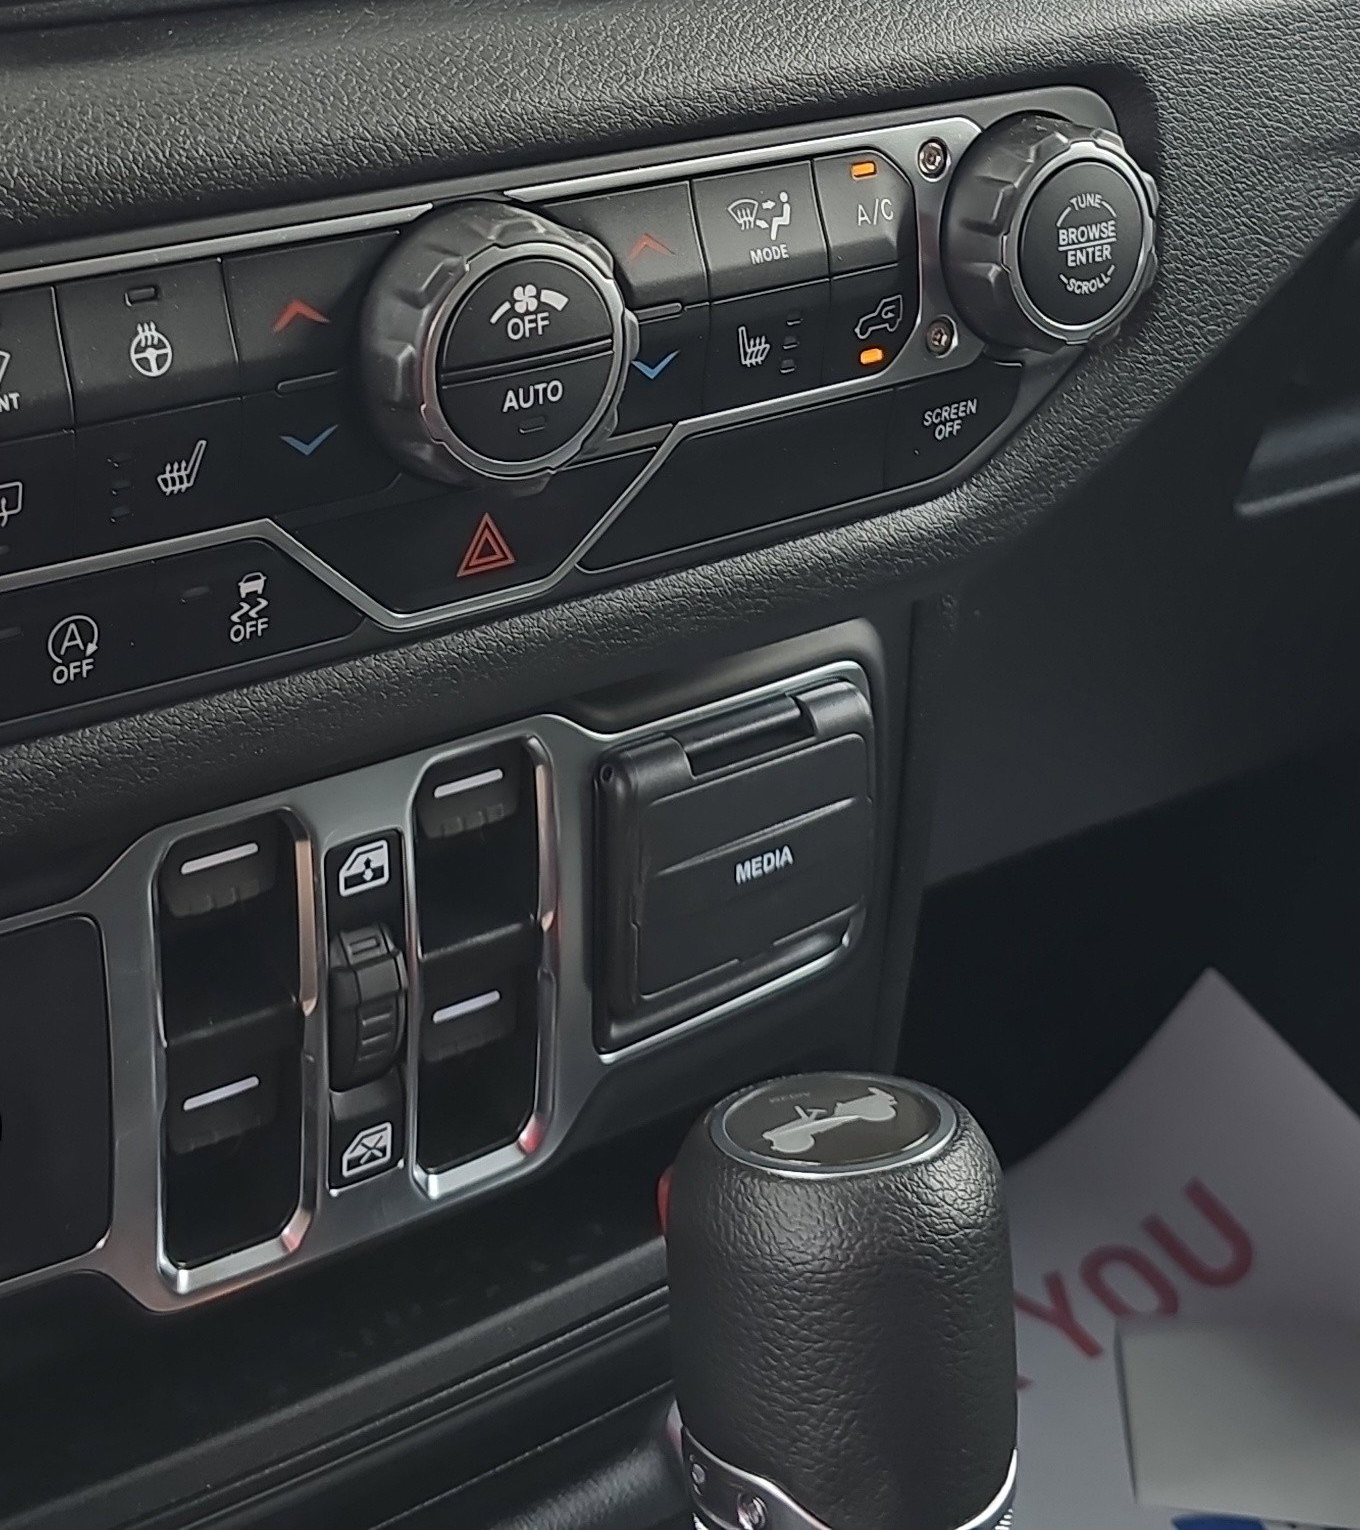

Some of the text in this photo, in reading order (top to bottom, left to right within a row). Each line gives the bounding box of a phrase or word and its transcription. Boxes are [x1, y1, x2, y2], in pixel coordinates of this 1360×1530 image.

[856, 198, 895, 227] A/C
[1070, 193, 1103, 211] TUNE
[1057, 220, 1117, 246] BROWSE
[750, 244, 790, 265] MODE
[1066, 243, 1113, 268] ENTER
[1066, 271, 1112, 296] SCROLL
[506, 313, 551, 342] OFF
[502, 380, 564, 413] AUTO
[923, 398, 978, 427] SCREEN
[934, 419, 964, 441] OFF
[229, 618, 270, 643] OFF
[51, 660, 95, 685] OFF
[734, 845, 795, 885] MEDIA
[1014, 1176, 1254, 1360] YOU
